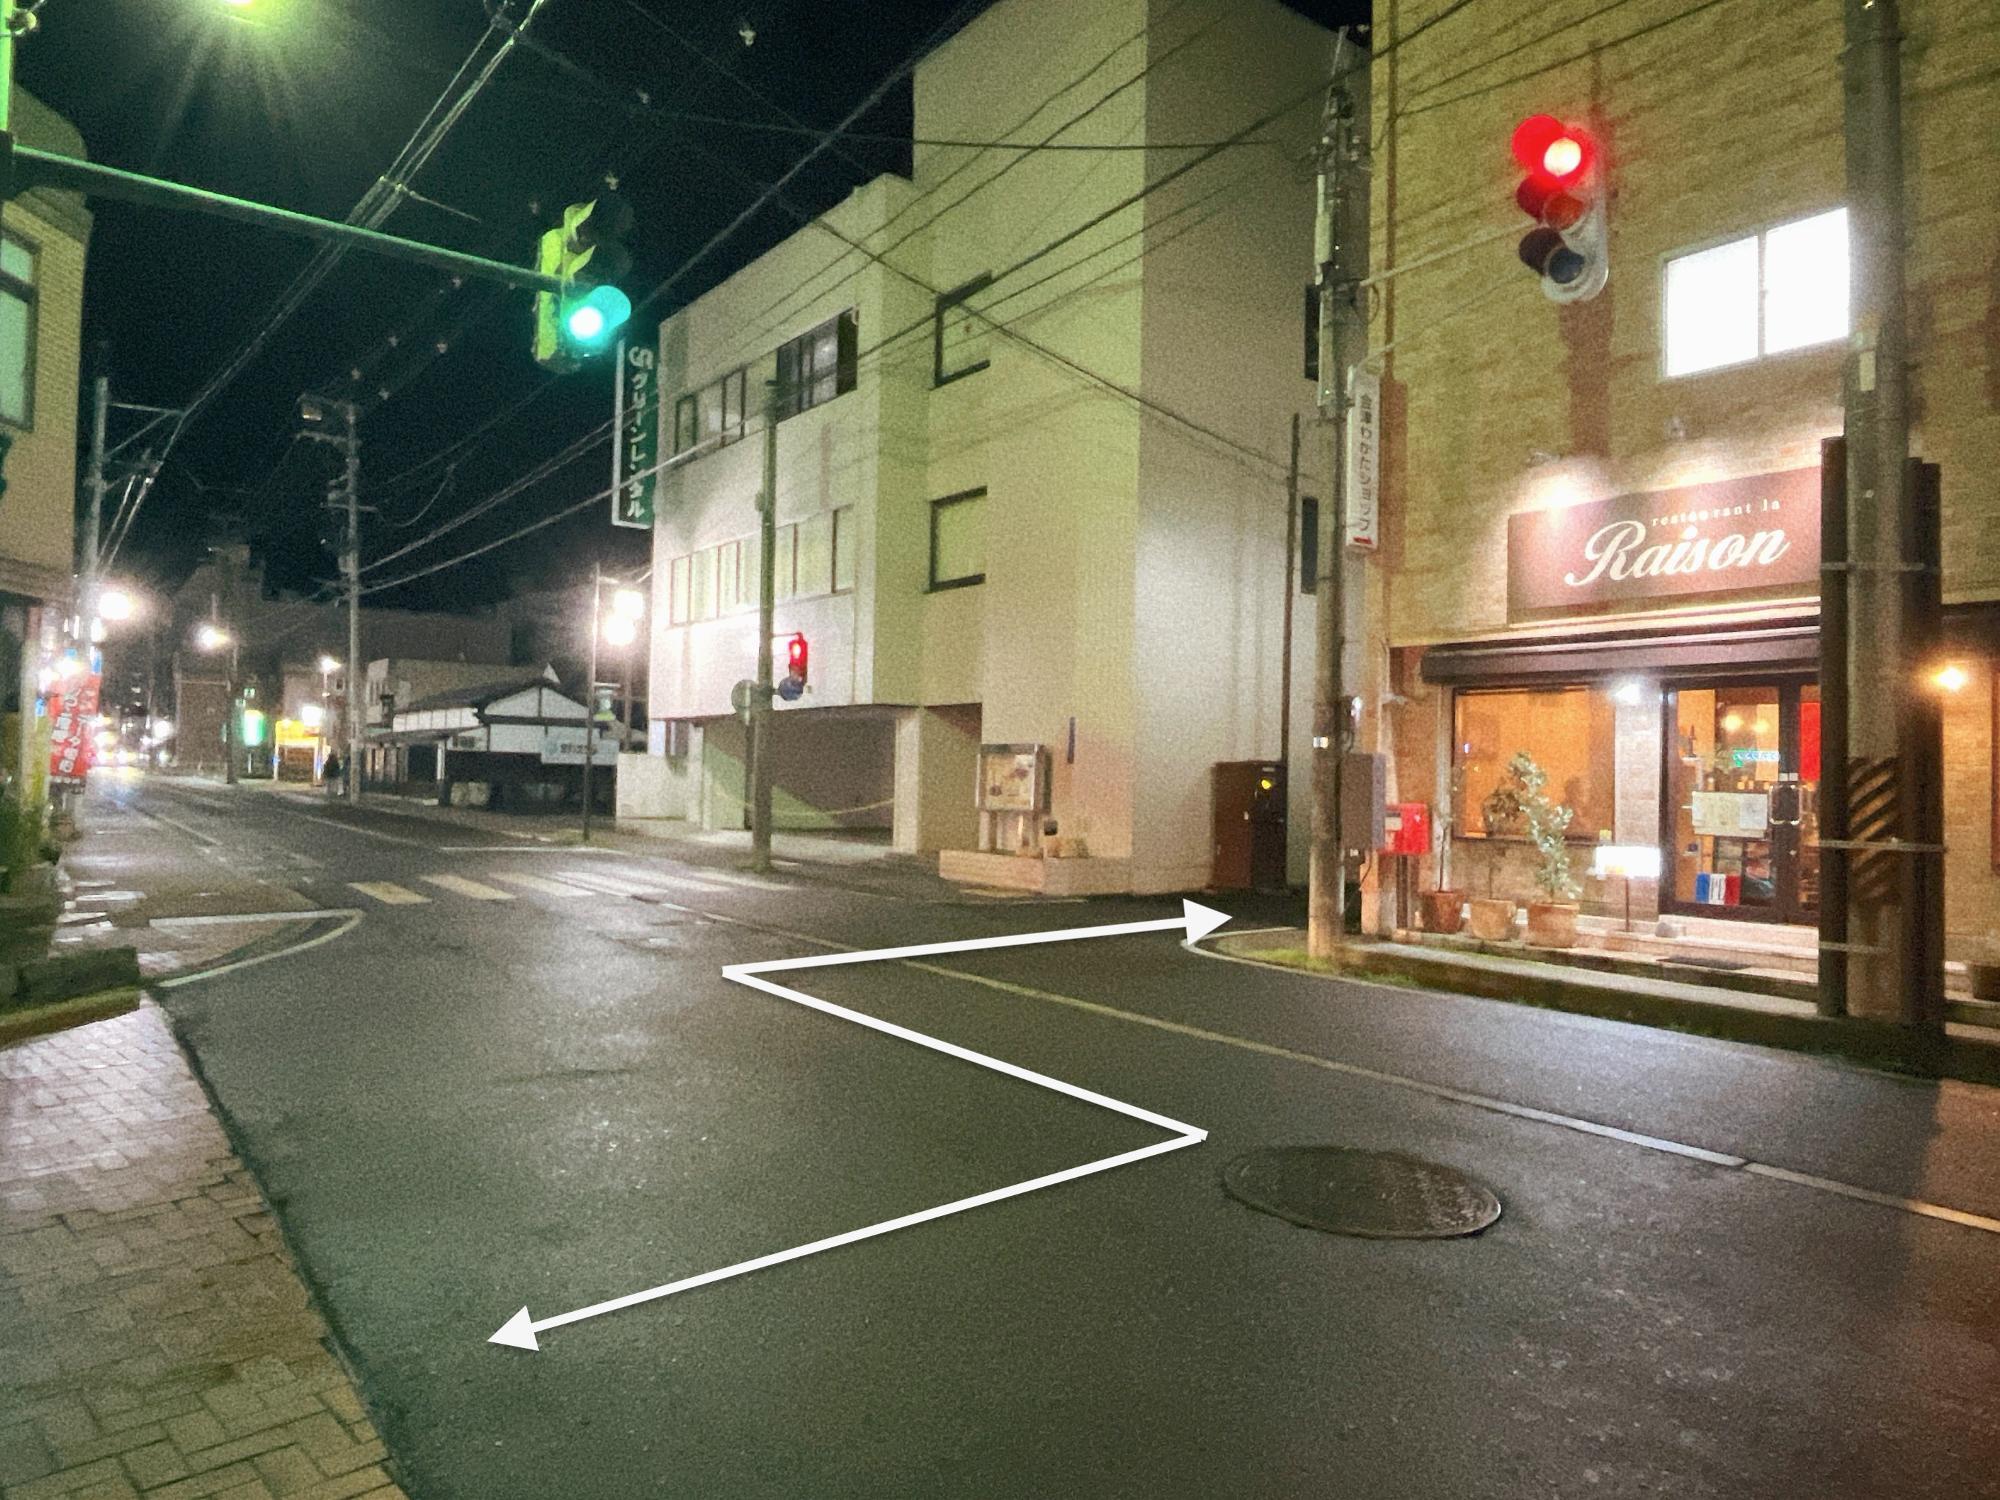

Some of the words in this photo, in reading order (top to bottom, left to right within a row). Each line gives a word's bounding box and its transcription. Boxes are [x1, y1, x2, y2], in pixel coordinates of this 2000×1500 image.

[1651, 504, 1751, 526] restaurant
[1761, 499, 1780, 511] la
[1564, 520, 1791, 586] Raison
